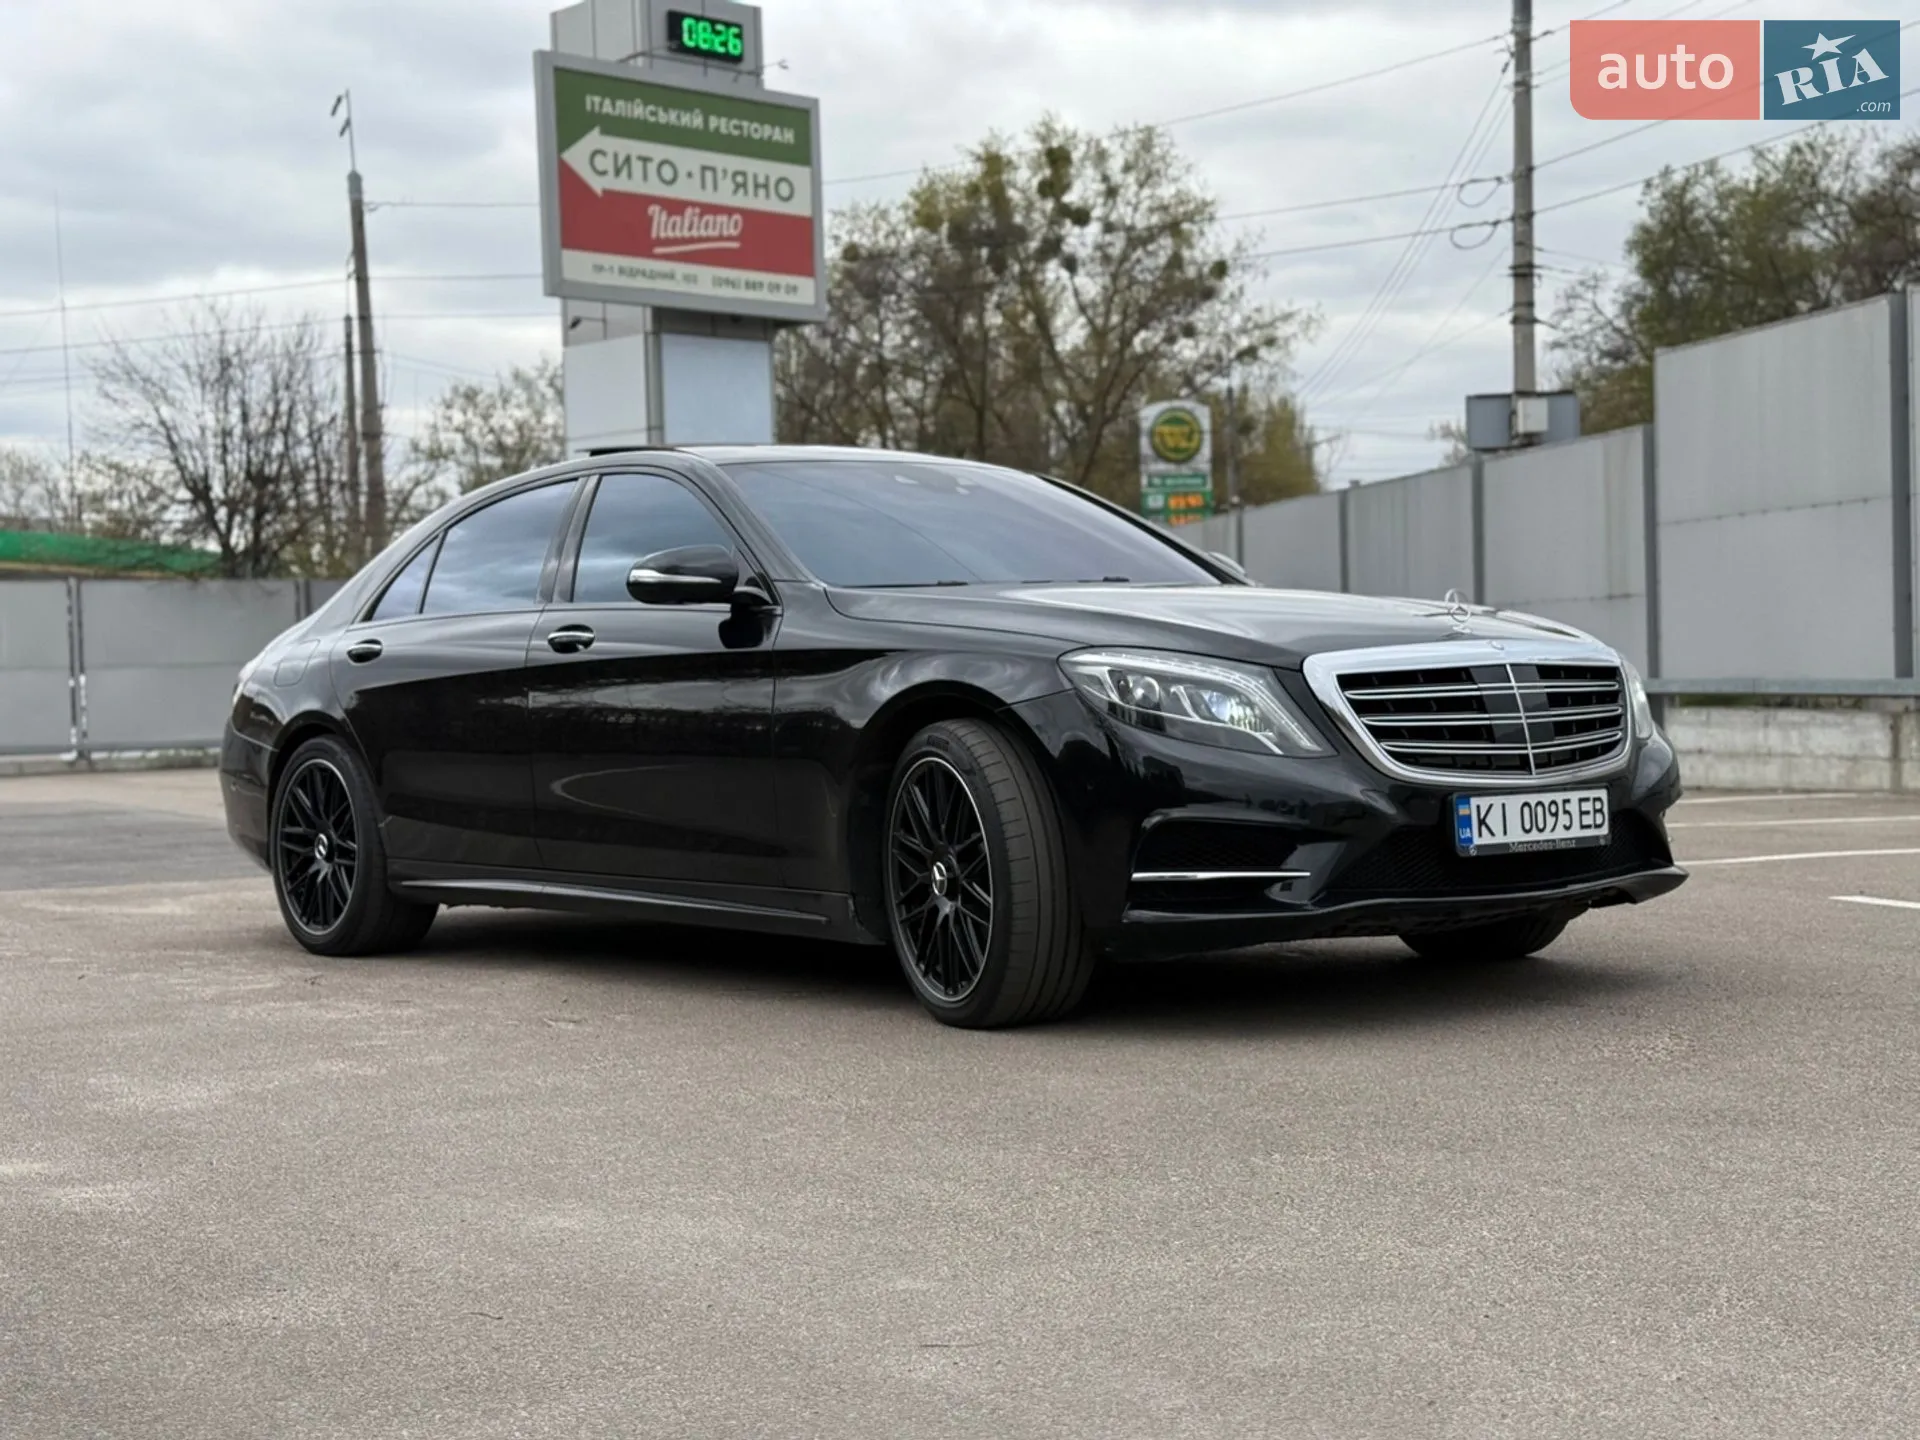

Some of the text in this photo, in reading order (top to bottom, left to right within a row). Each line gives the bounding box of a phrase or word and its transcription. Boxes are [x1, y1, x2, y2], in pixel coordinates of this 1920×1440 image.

[585, 94, 795, 144] ІТАЛІЙСЬКИЙ РЕСТОРАН
[588, 148, 679, 187] СИТО
[648, 204, 743, 240] Italiano
[1459, 828, 1472, 839] UA
[1476, 797, 1606, 838] KI 0095 EB
[1509, 839, 1576, 852] Mercedes-Benz
